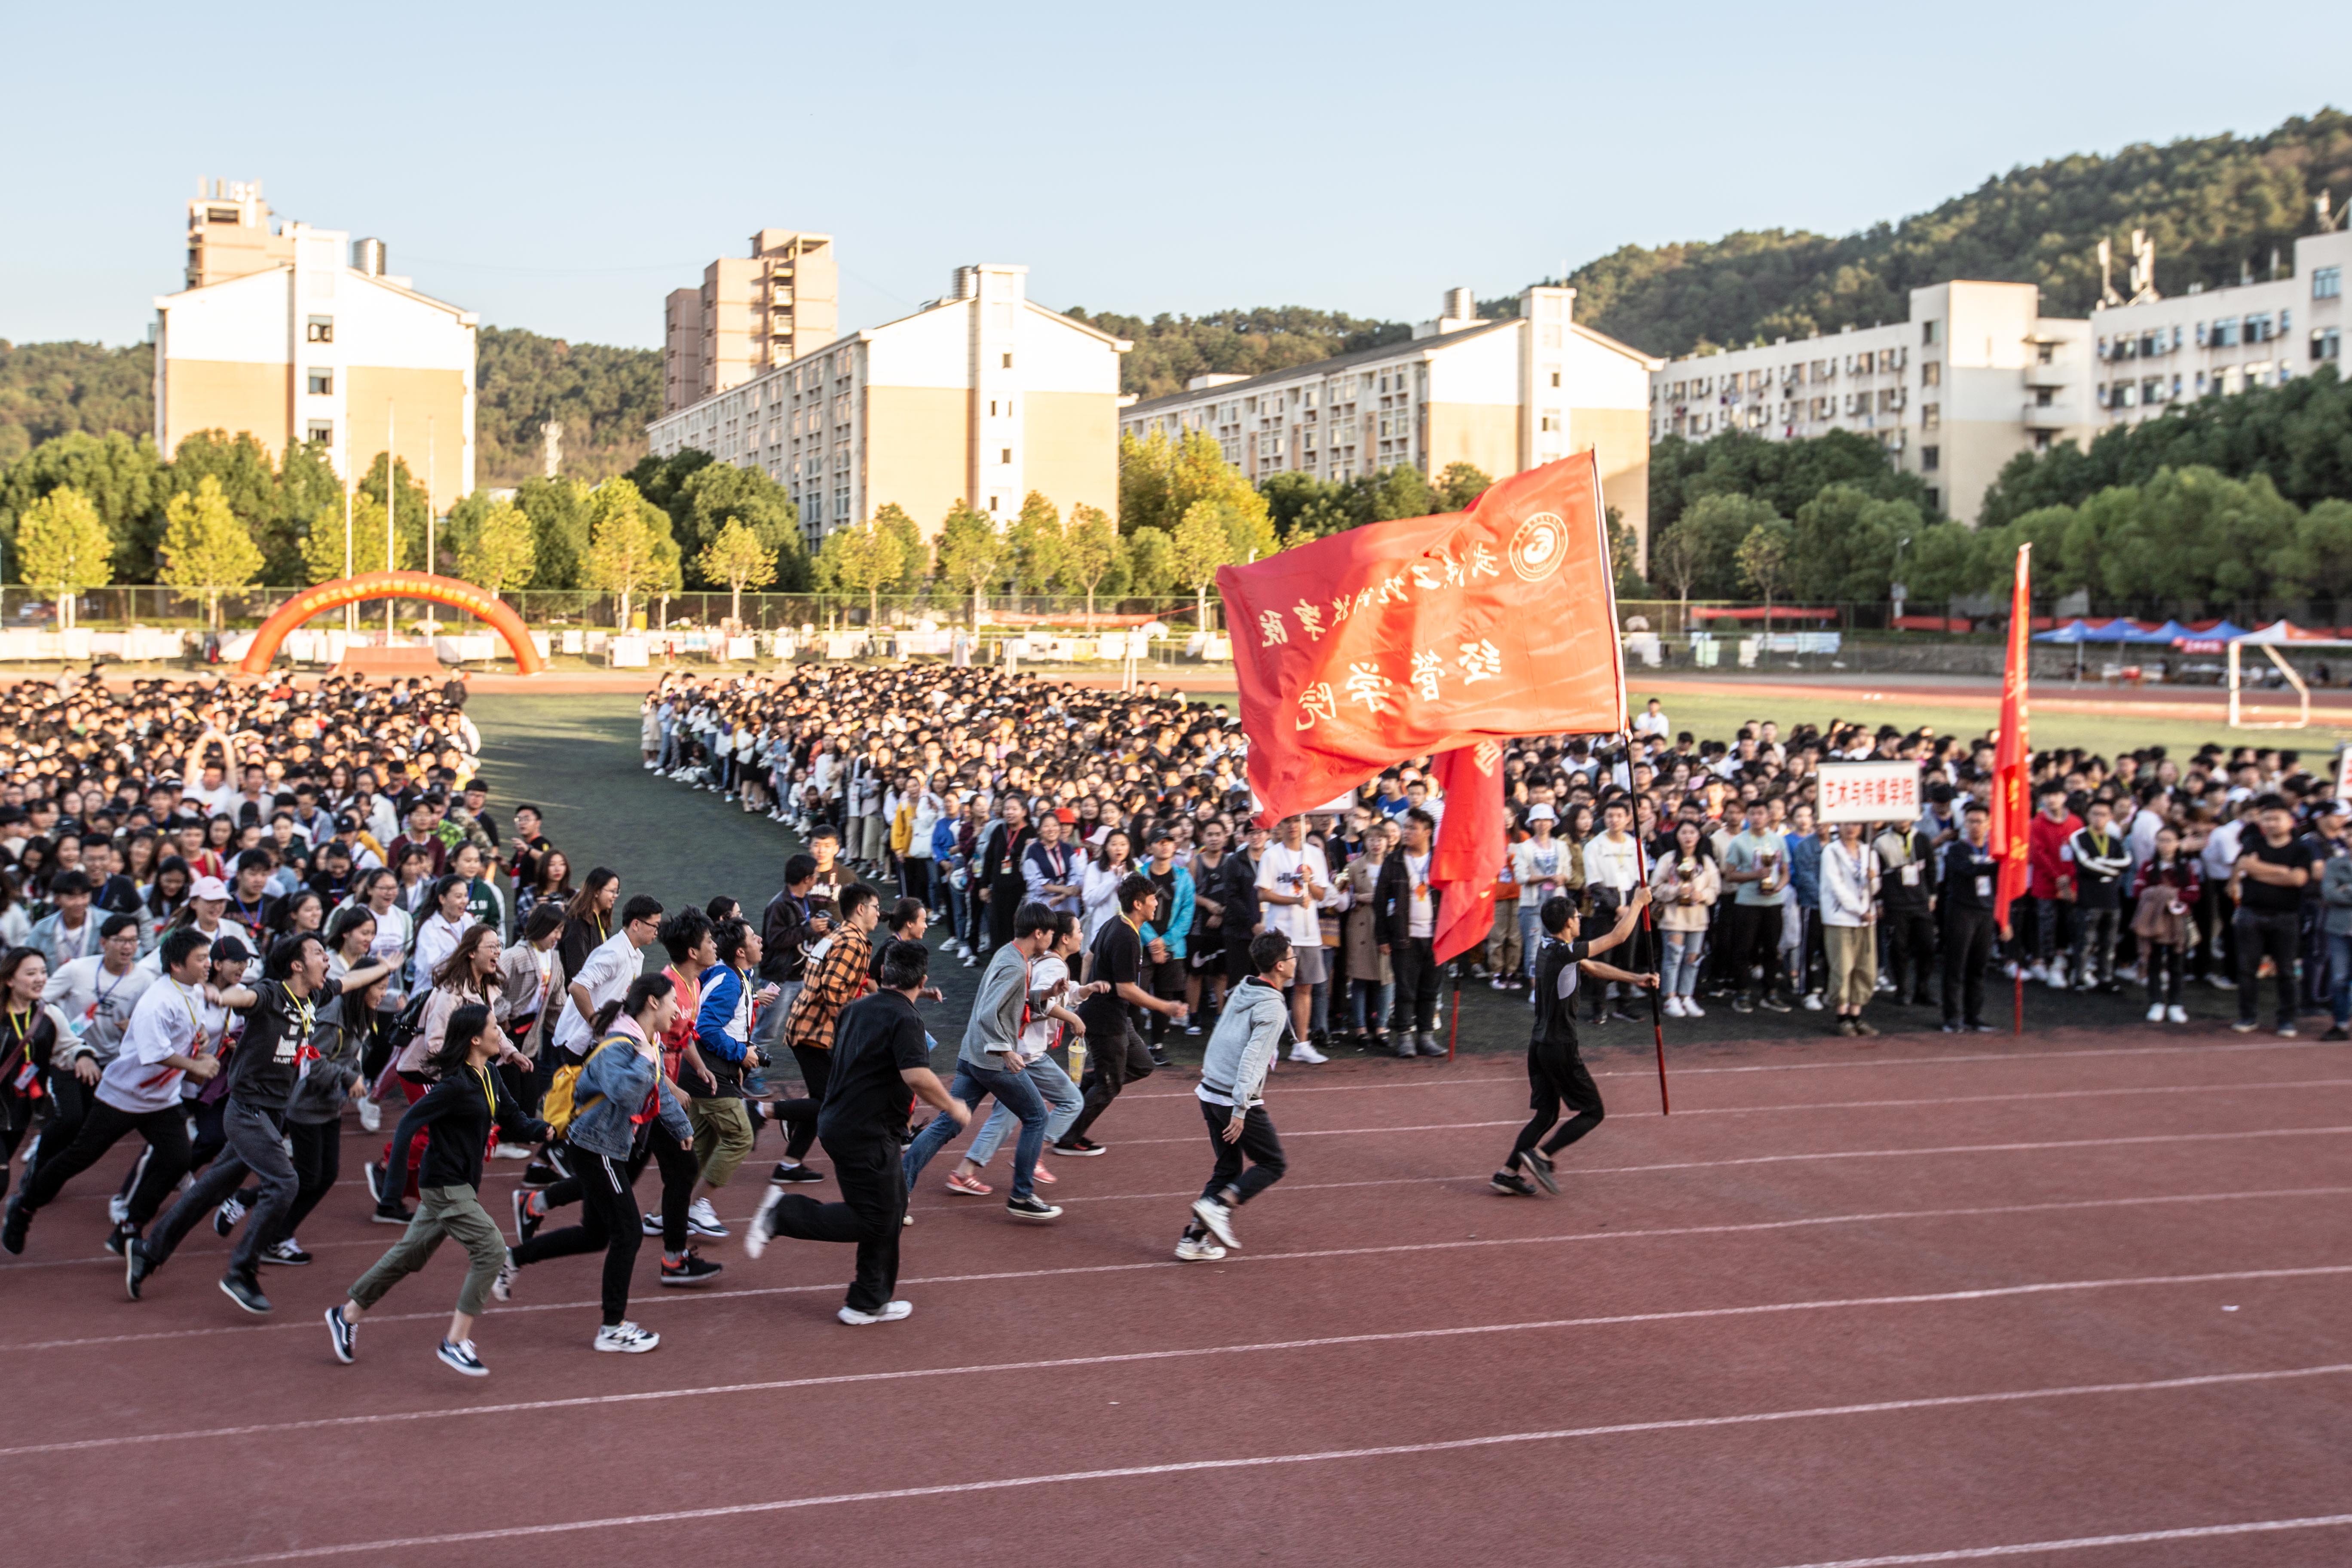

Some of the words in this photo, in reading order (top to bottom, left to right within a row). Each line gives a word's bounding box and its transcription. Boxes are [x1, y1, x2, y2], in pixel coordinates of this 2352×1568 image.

[1825, 777, 1914, 808] 艺术与传媒学院
